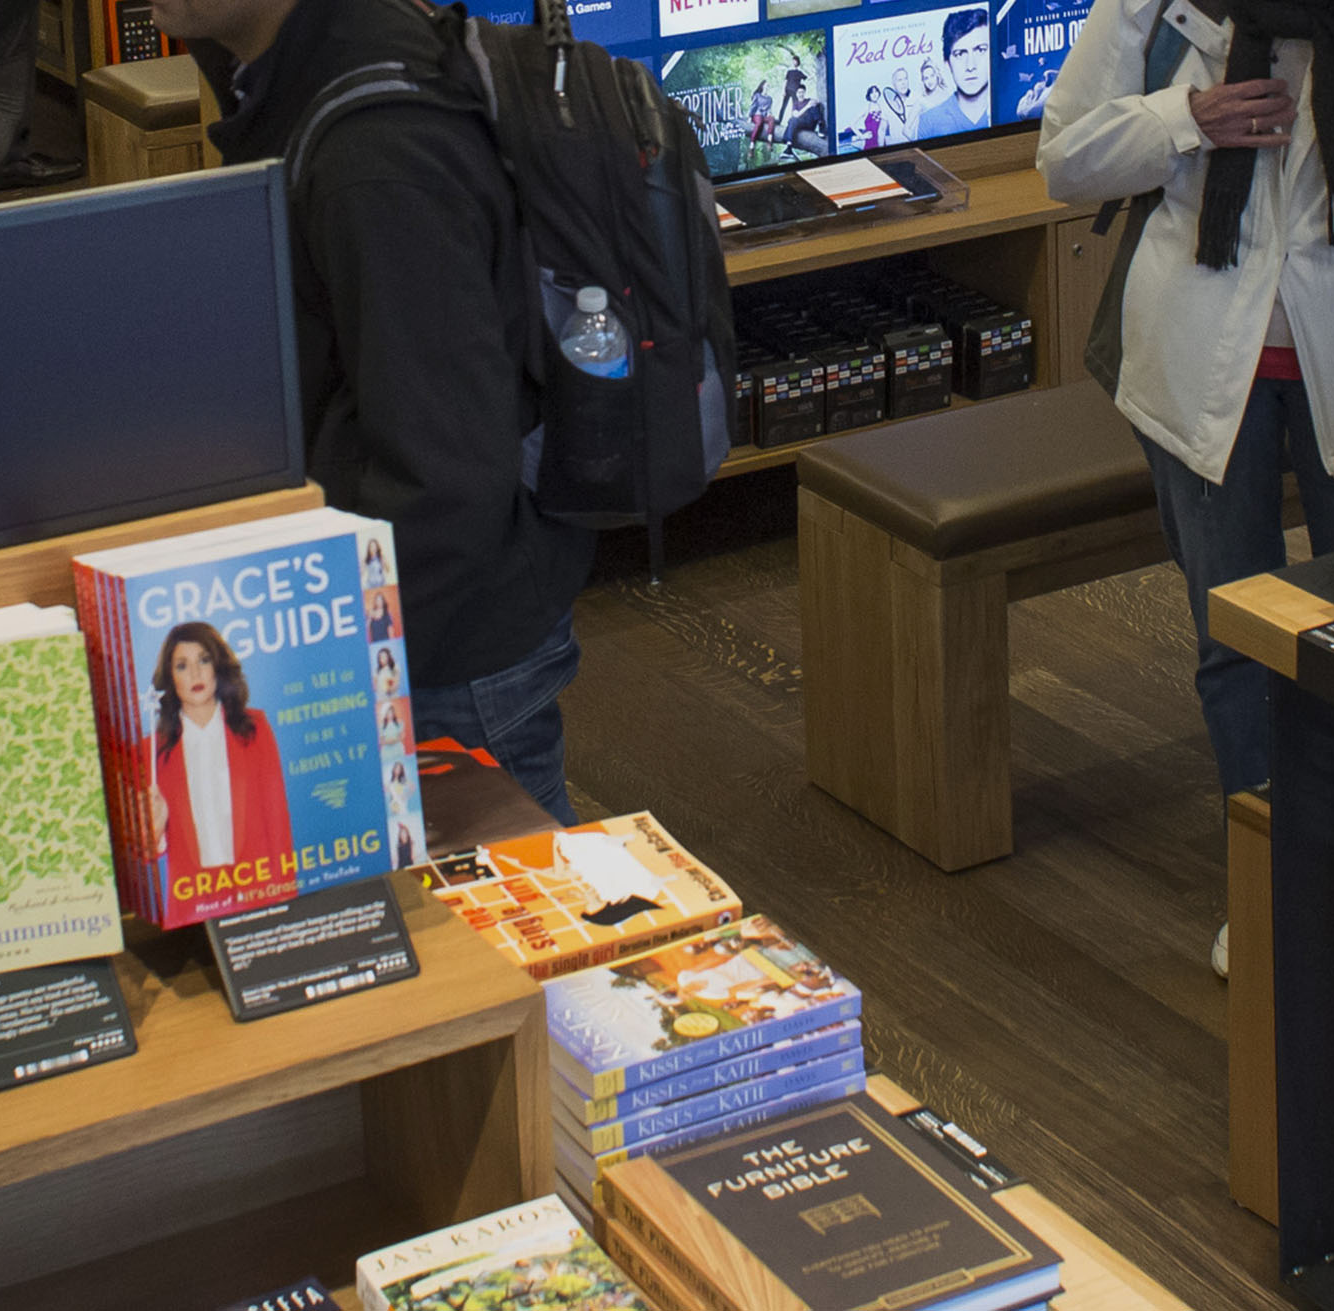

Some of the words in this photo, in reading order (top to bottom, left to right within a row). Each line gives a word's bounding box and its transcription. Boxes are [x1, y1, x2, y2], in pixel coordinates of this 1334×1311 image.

[575, 0, 612, 16] Games
[846, 40, 886, 66] Red
[892, 34, 933, 56] Oaks
[1023, 26, 1065, 57] HAND
[138, 552, 330, 628] GRACE'S
[222, 594, 360, 660] GUIDE
[173, 856, 272, 901] GRACE
[280, 829, 382, 875] HELBIG
[639, 1051, 694, 1083] KISSES
[707, 1137, 871, 1198] FURNITURE
[742, 1139, 804, 1167] THE
[762, 1163, 849, 1200] BIBLE
